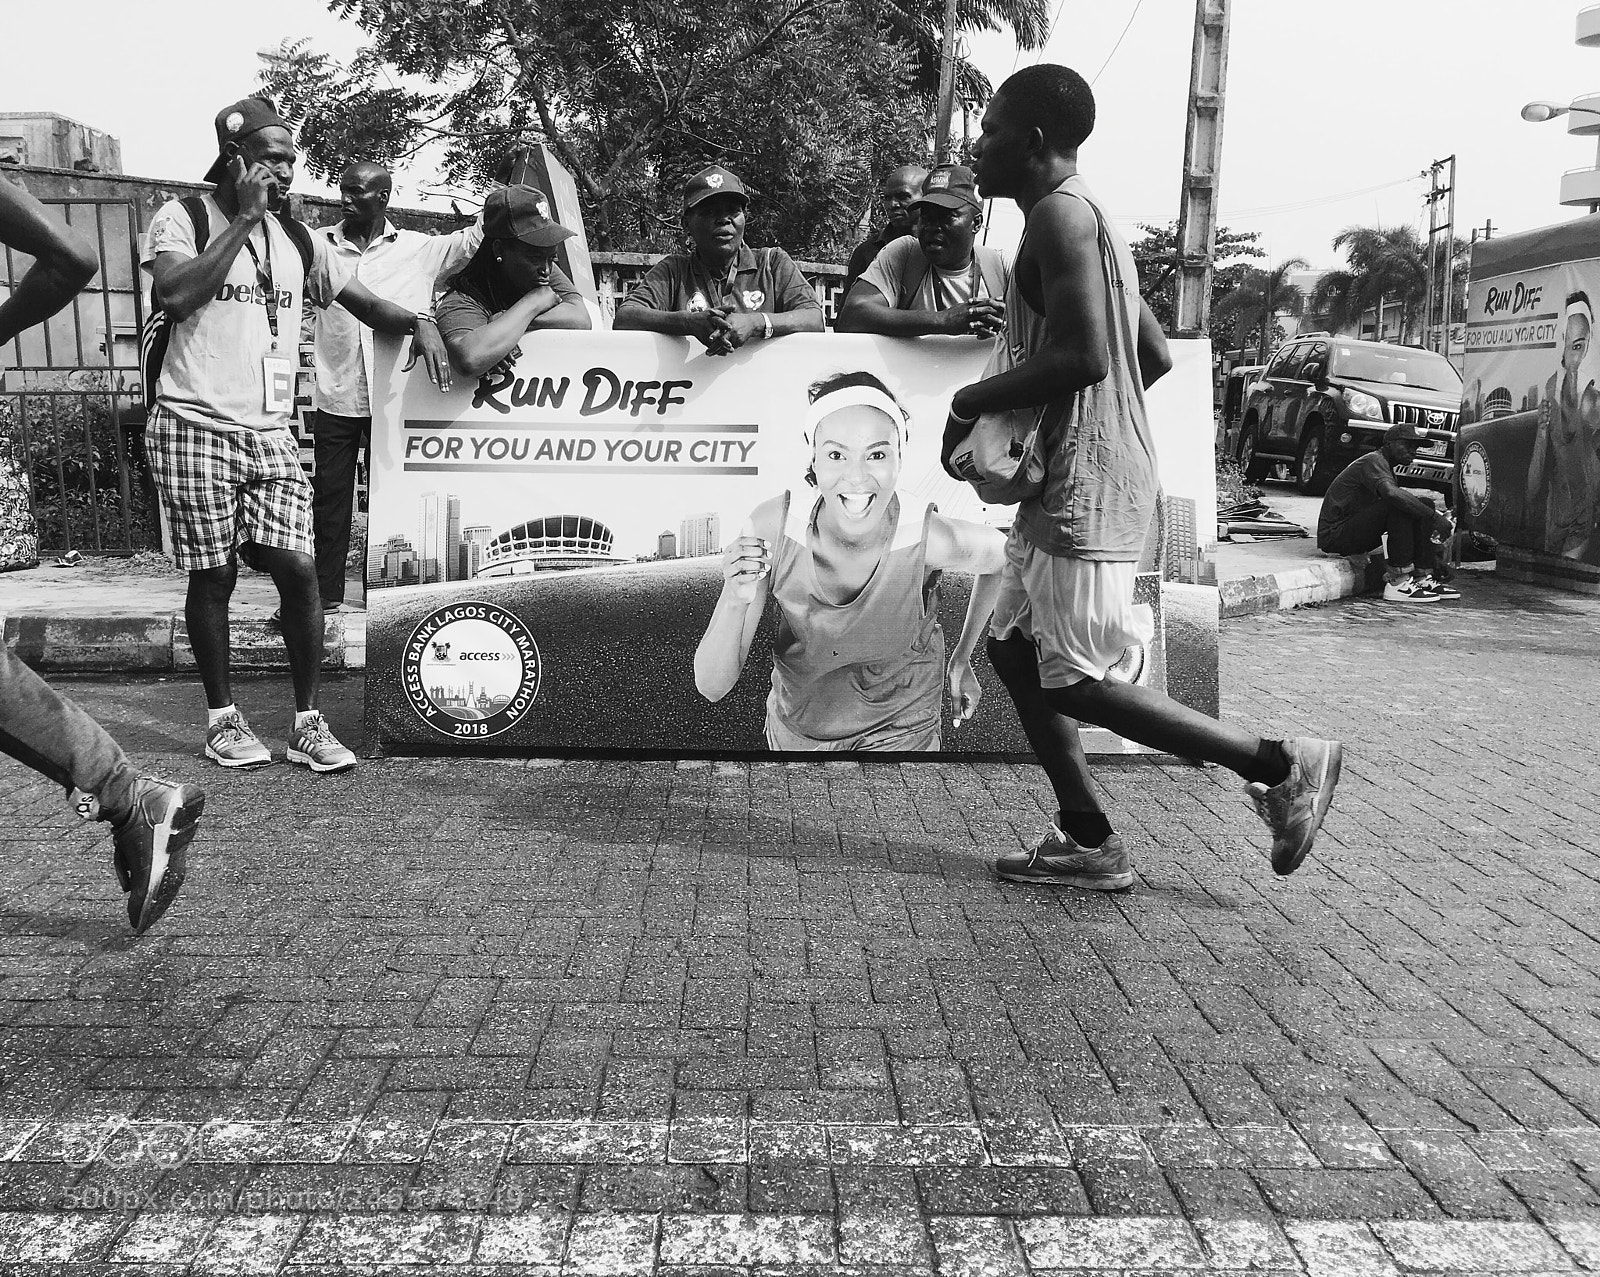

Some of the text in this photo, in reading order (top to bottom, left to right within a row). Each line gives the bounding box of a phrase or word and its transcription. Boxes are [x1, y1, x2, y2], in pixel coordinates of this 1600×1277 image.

[1484, 282, 1542, 316] RUN DIFF
[1466, 331, 1482, 345] FOR
[1483, 330, 1498, 345] YOU
[1537, 324, 1557, 340] CITY
[472, 367, 693, 417] RUN DIFF
[405, 436, 757, 463] FOR YOU AND YOUR CITY
[407, 606, 536, 720] ACCESS BANK LAGOS CITY MARATHON
[459, 652, 500, 661] access
[454, 724, 488, 734] 2018
